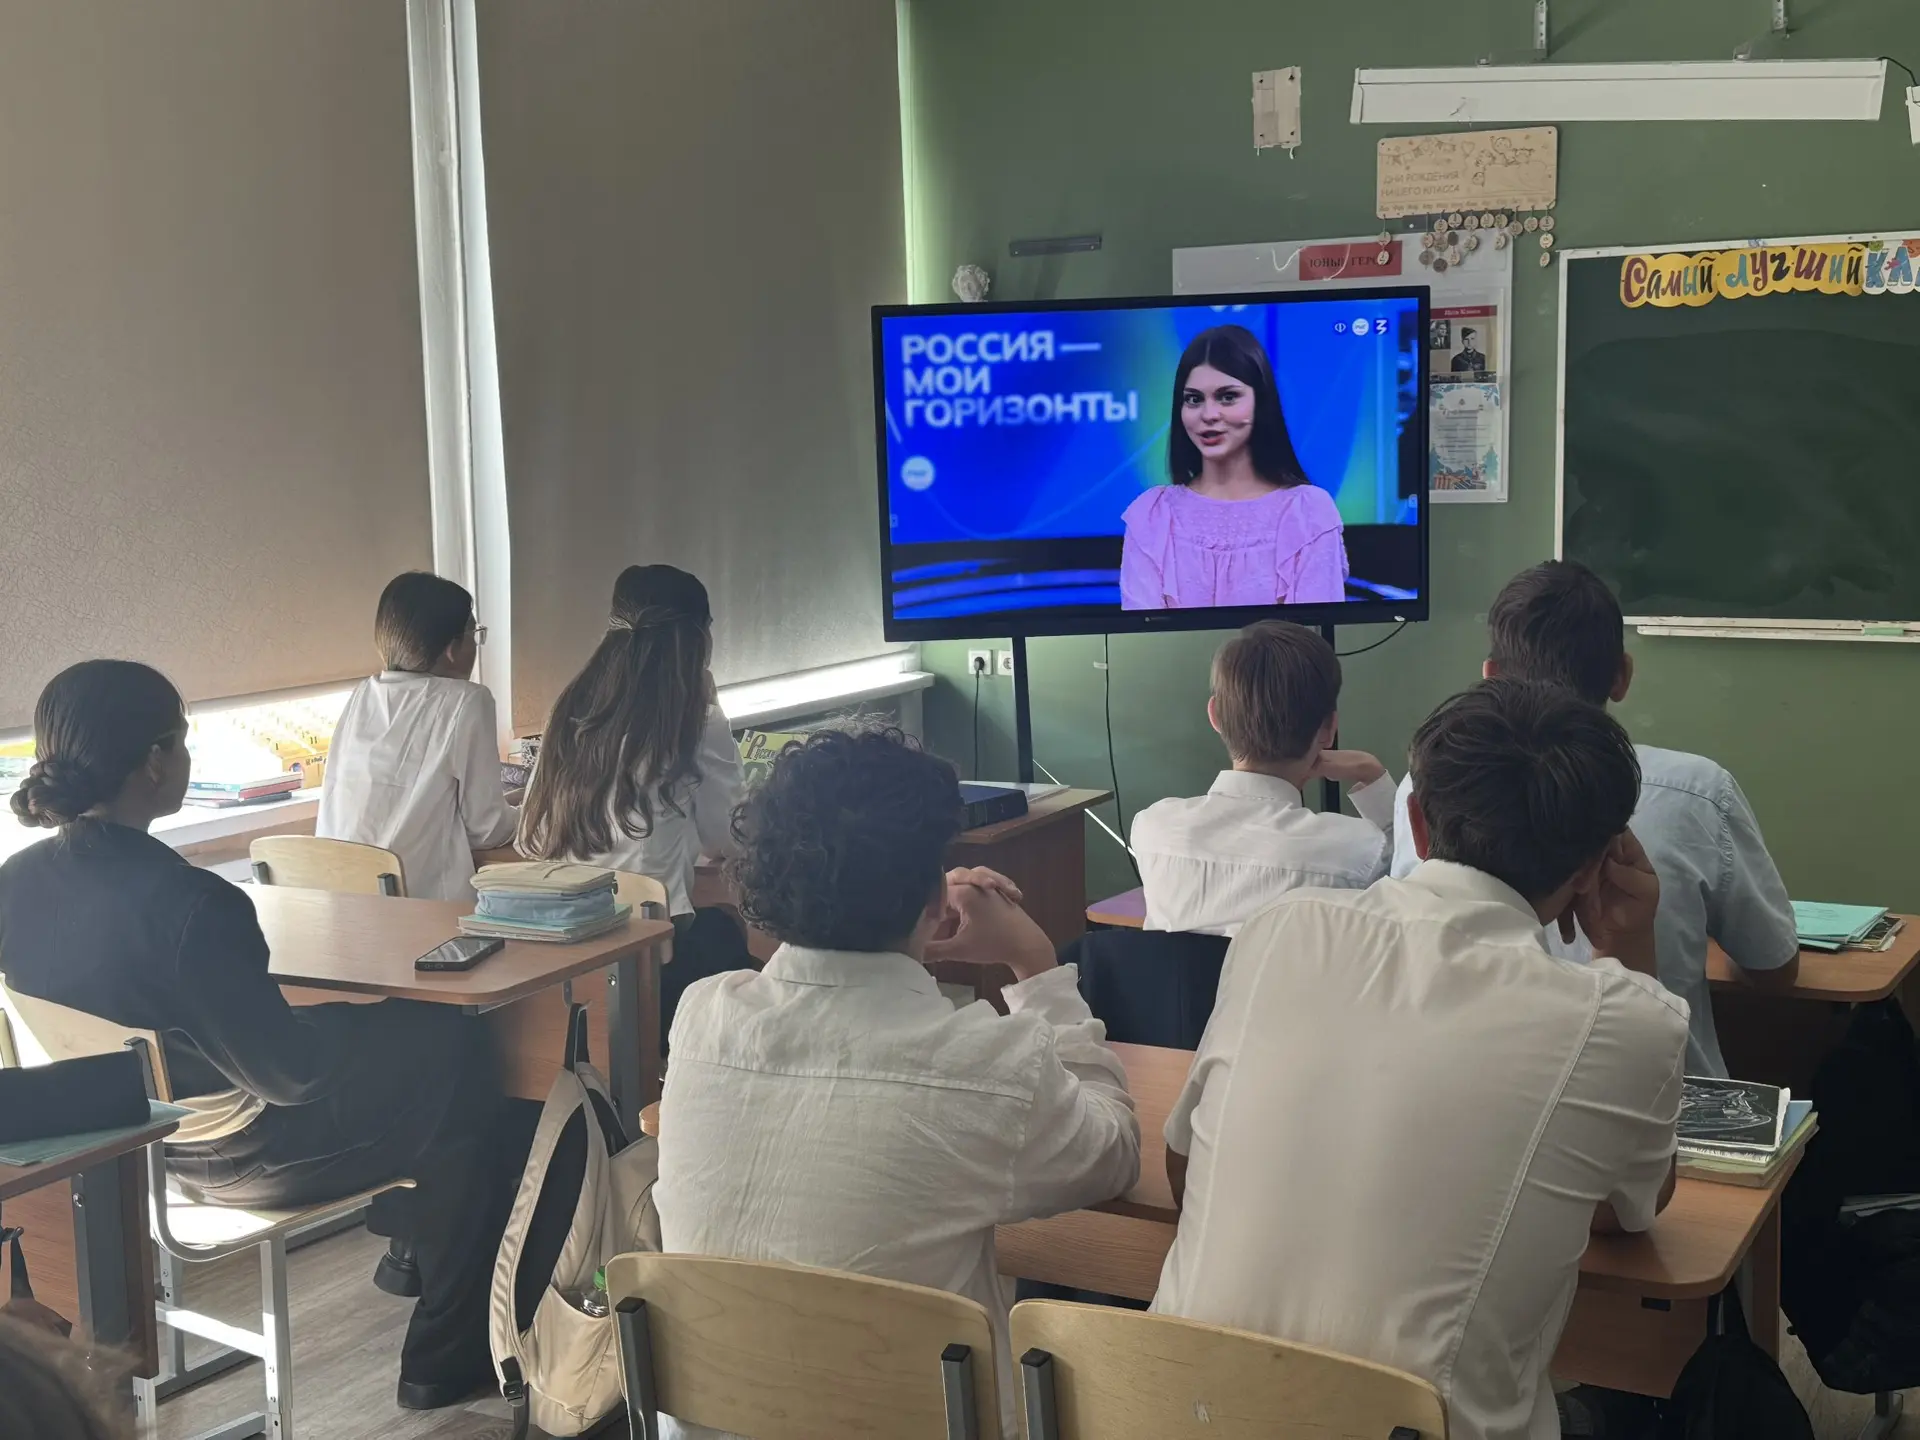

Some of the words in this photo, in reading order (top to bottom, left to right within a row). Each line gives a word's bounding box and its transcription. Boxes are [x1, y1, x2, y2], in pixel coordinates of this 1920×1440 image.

[1624, 257, 1716, 303] Самый
[1865, 245, 1920, 288] КЛ
[902, 330, 1053, 364] РОССИЯ
[903, 365, 991, 396] МОИ
[904, 390, 1138, 428] ГОРИЗОНТЫ
